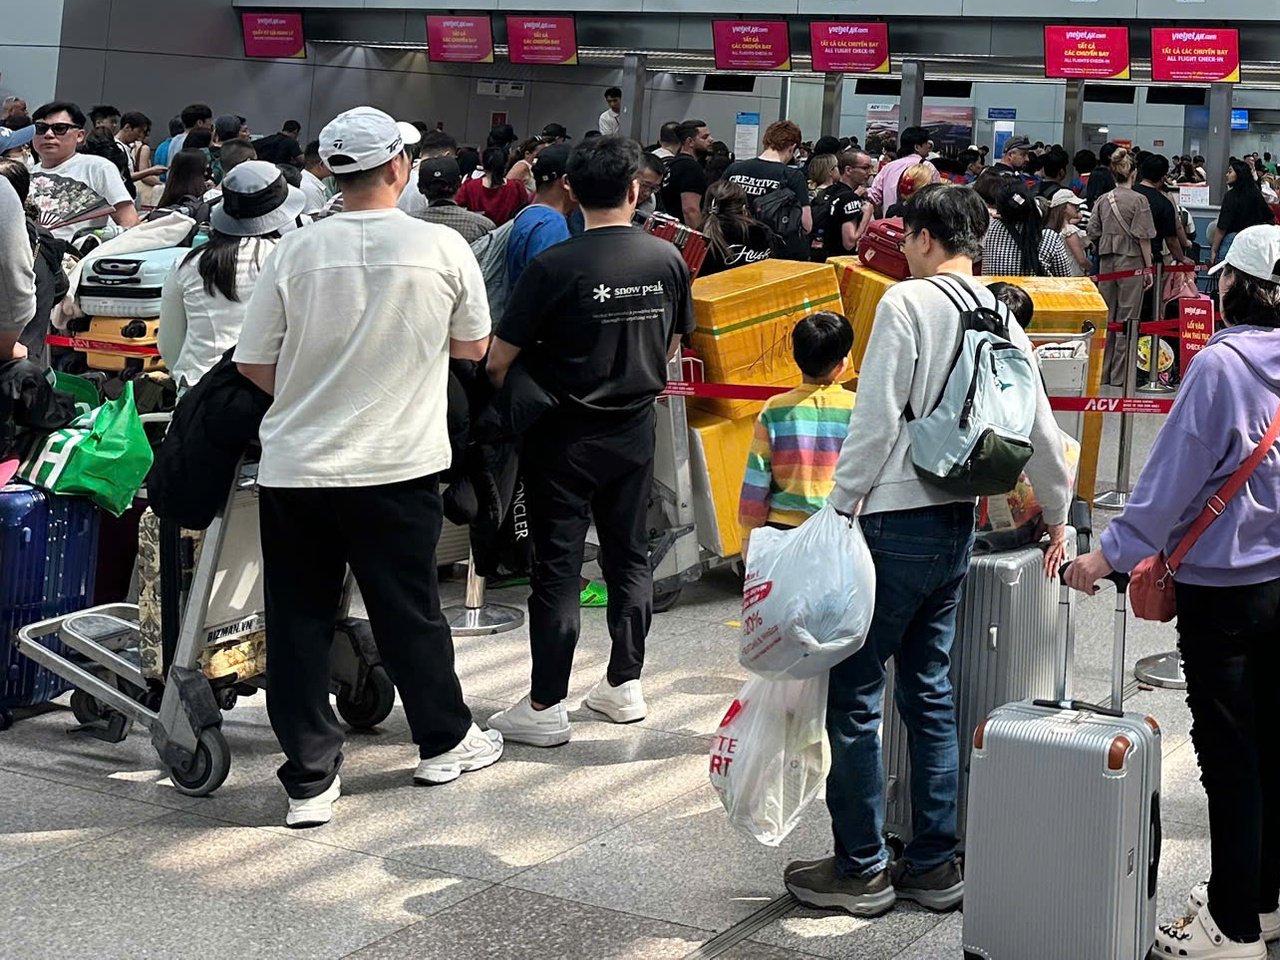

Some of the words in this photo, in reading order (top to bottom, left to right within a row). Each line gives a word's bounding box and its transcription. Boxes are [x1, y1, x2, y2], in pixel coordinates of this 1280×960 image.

[729, 175, 780, 189] CREATIVE
[740, 185, 767, 196] UILD
[614, 286, 641, 296] snow
[642, 280, 663, 296] peak
[1084, 398, 1120, 411] ACV
[513, 480, 529, 542] ONCLER
[207, 619, 253, 642] BIZMAN.VN
[710, 754, 733, 777] RT
